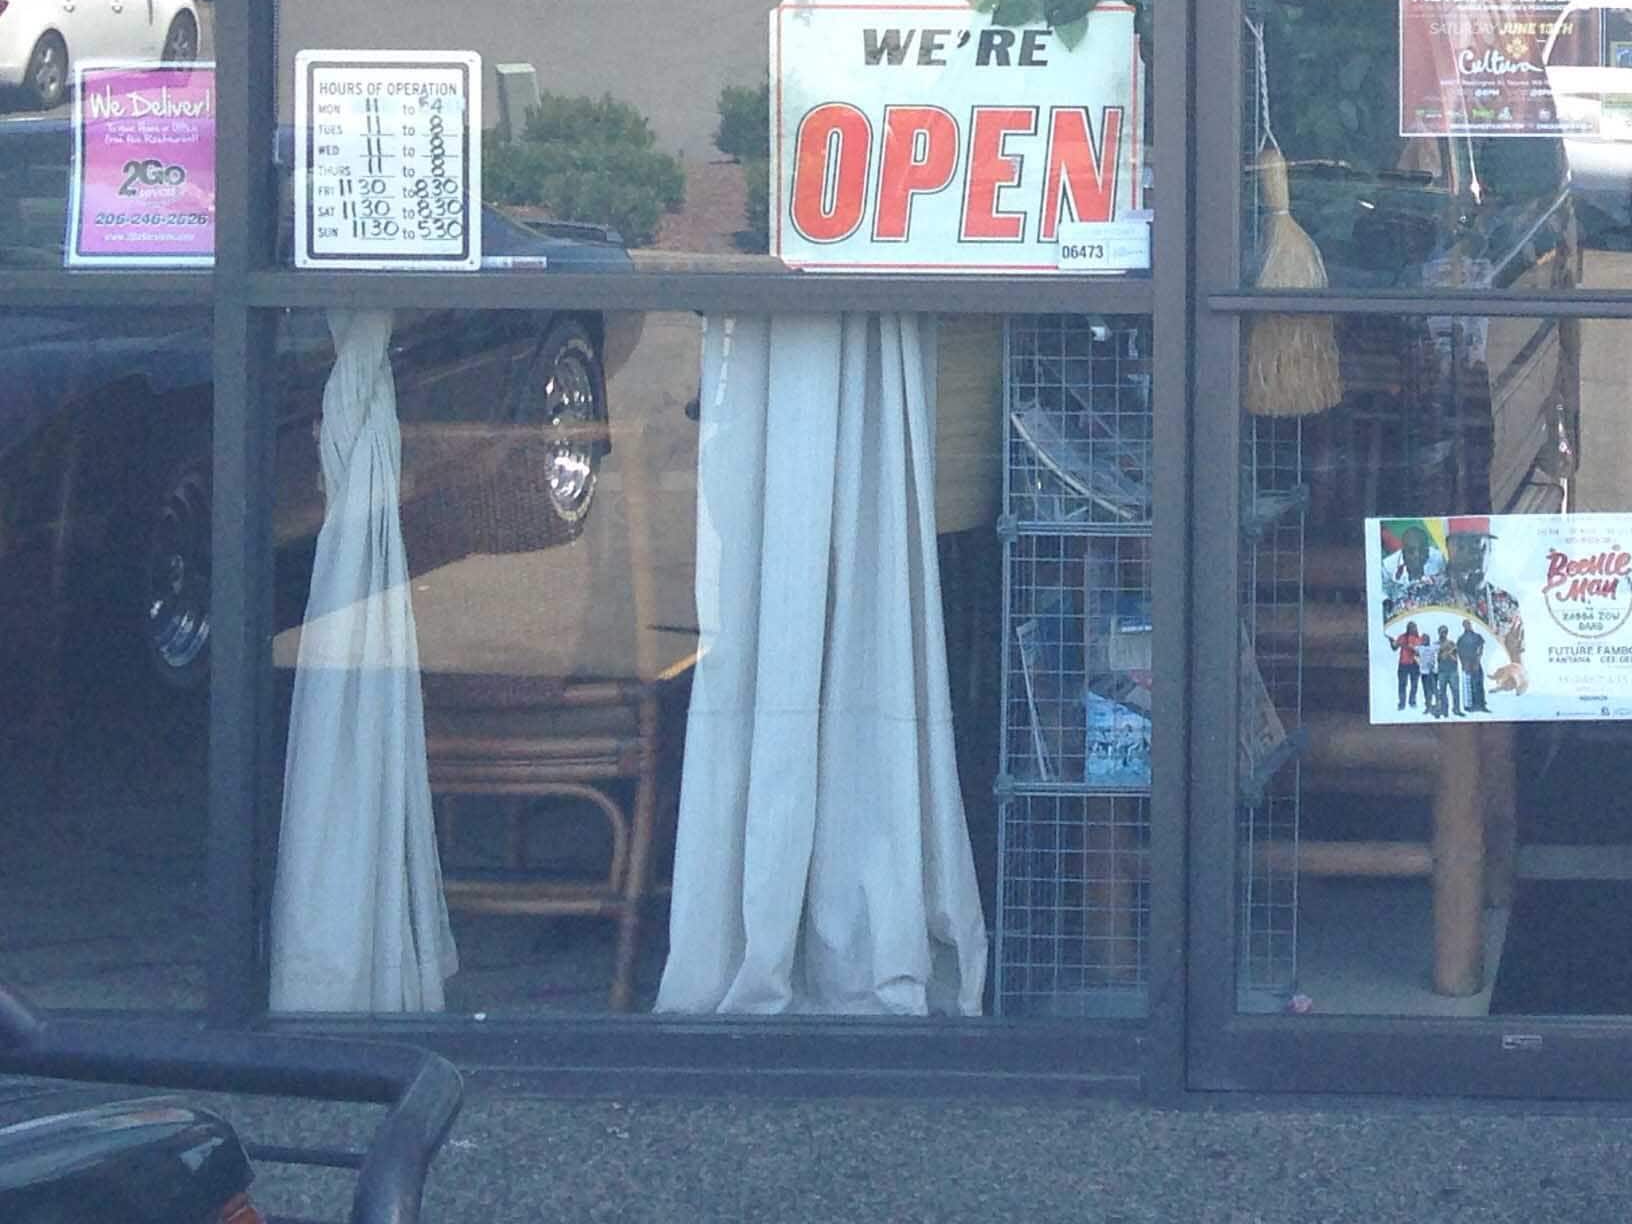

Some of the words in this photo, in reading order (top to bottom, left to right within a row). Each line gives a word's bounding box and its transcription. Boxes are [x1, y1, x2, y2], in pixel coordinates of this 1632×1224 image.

[863, 28, 1053, 66] WE'RE
[319, 82, 362, 96] HOURS
[366, 82, 382, 95] OF
[386, 82, 457, 96] OPERATION
[90, 84, 125, 118] We
[127, 85, 210, 117] Deliver!
[318, 103, 341, 114] MON
[402, 104, 416, 115] to
[318, 124, 343, 135] TUES
[402, 124, 415, 136] to
[318, 145, 340, 156] WED
[402, 145, 415, 157] to
[403, 166, 415, 177] to
[789, 101, 1124, 244] OPEN
[402, 207, 415, 219] to
[402, 229, 415, 239] to
[1062, 244, 1104, 259] 06473
